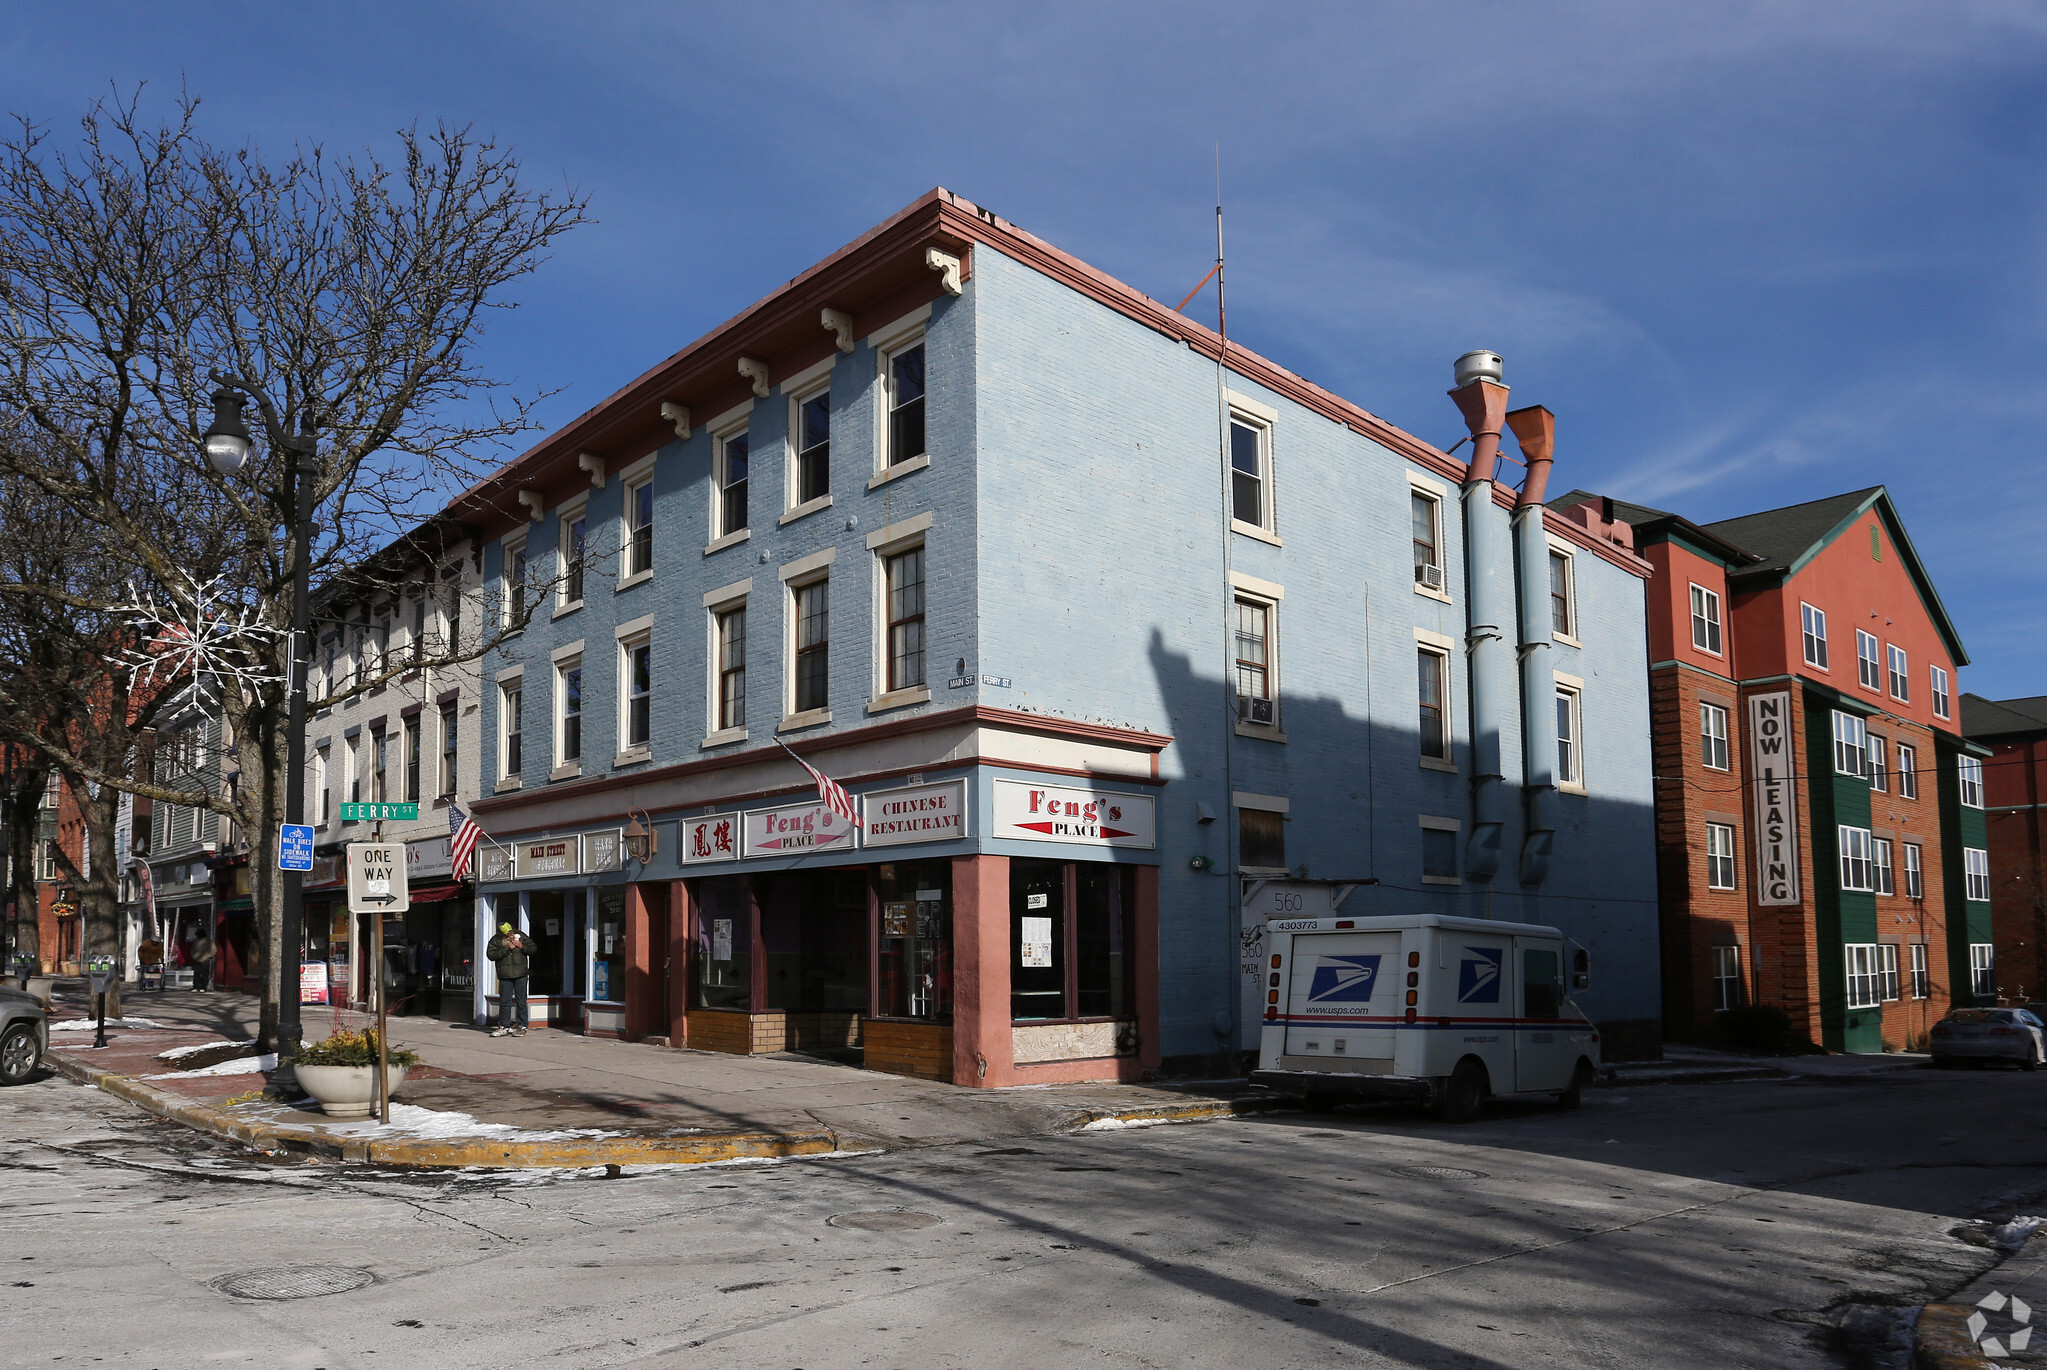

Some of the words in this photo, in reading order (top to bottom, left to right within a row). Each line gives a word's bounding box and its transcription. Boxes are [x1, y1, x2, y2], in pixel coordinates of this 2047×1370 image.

[950, 677, 964, 688] MAIN
[964, 676, 975, 684] ST.
[983, 676, 1001, 686] FERRY
[1002, 678, 1011, 688] ST.
[1759, 698, 1782, 755] NOW
[348, 805, 398, 818] FERRY
[882, 795, 948, 816] CHINESE
[1028, 790, 1122, 824] Feng's
[765, 808, 833, 835] Feng's
[871, 814, 961, 835] RESTAURANT
[1055, 823, 1099, 838] PLACE
[1764, 767, 1787, 900] LEASING
[297, 838, 312, 846] BIKES
[692, 820, 733, 858] 鳳樓
[782, 833, 815, 848] PLACE
[364, 850, 392, 863] ONE
[530, 846, 545, 859] MAIN
[546, 843, 566, 857] STREET
[364, 868, 393, 881] WAY
[1274, 892, 1303, 912] 560
[1278, 920, 1318, 930] 4303773
[1242, 942, 1263, 959] 560
[1242, 963, 1259, 975] MAIN
[1253, 974, 1262, 984] ST.
[1306, 1006, 1369, 1016] www.usps.com
